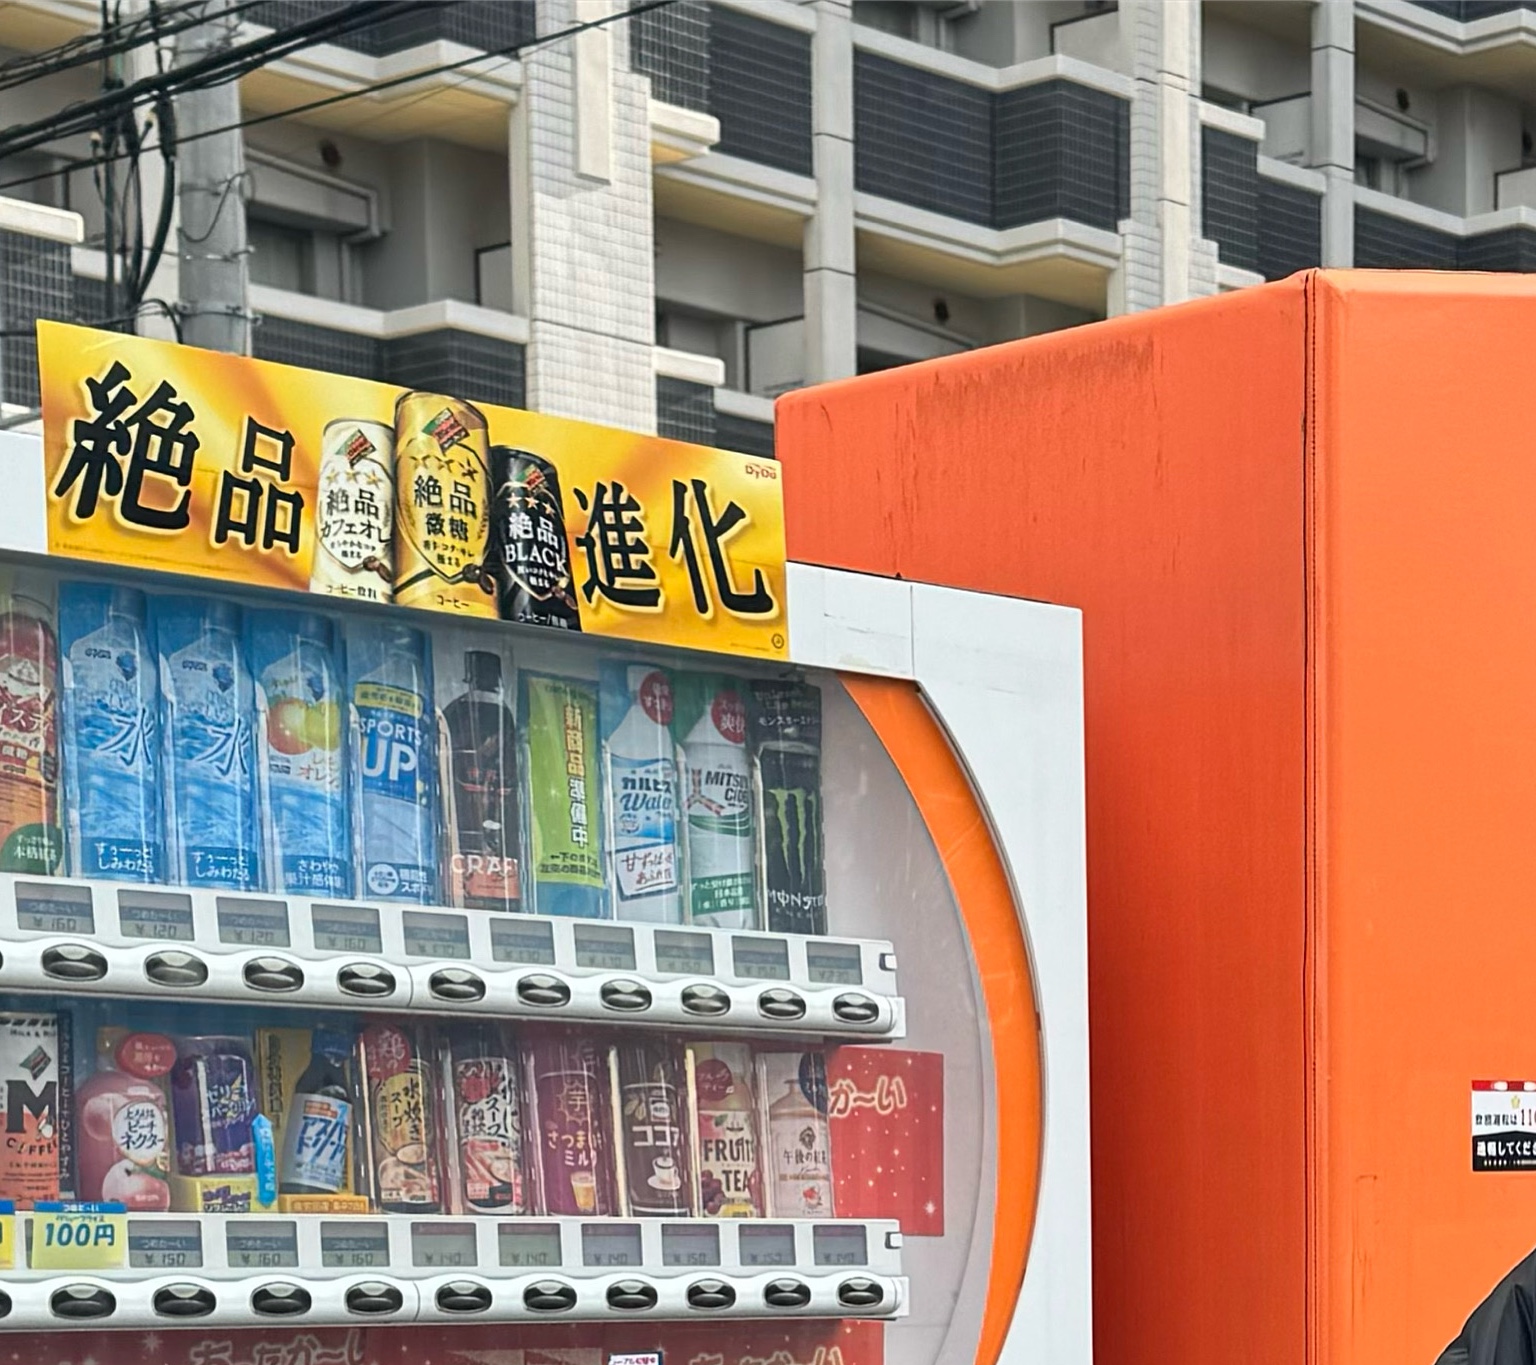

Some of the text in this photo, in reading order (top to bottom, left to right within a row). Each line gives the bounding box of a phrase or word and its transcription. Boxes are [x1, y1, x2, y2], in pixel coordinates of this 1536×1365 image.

[54, 360, 774, 614] 絶品 進化
[414, 475, 477, 520] 絶品
[326, 488, 379, 520] 絶品
[425, 512, 469, 543] 微糖
[508, 511, 558, 550] 絶品
[505, 544, 567, 574] BLACK
[436, 595, 470, 609] コーヒー
[95, 708, 154, 766] 水
[192, 718, 249, 776] 水
[359, 717, 422, 746] SPORTS
[361, 735, 417, 781] UP
[402, 1077, 422, 1141] 水炊き
[121, 1133, 165, 1150] ネクター
[127, 1121, 157, 1134] ピーチ
[722, 1169, 750, 1193] TEA
[46, 1222, 115, 1247] 100円
